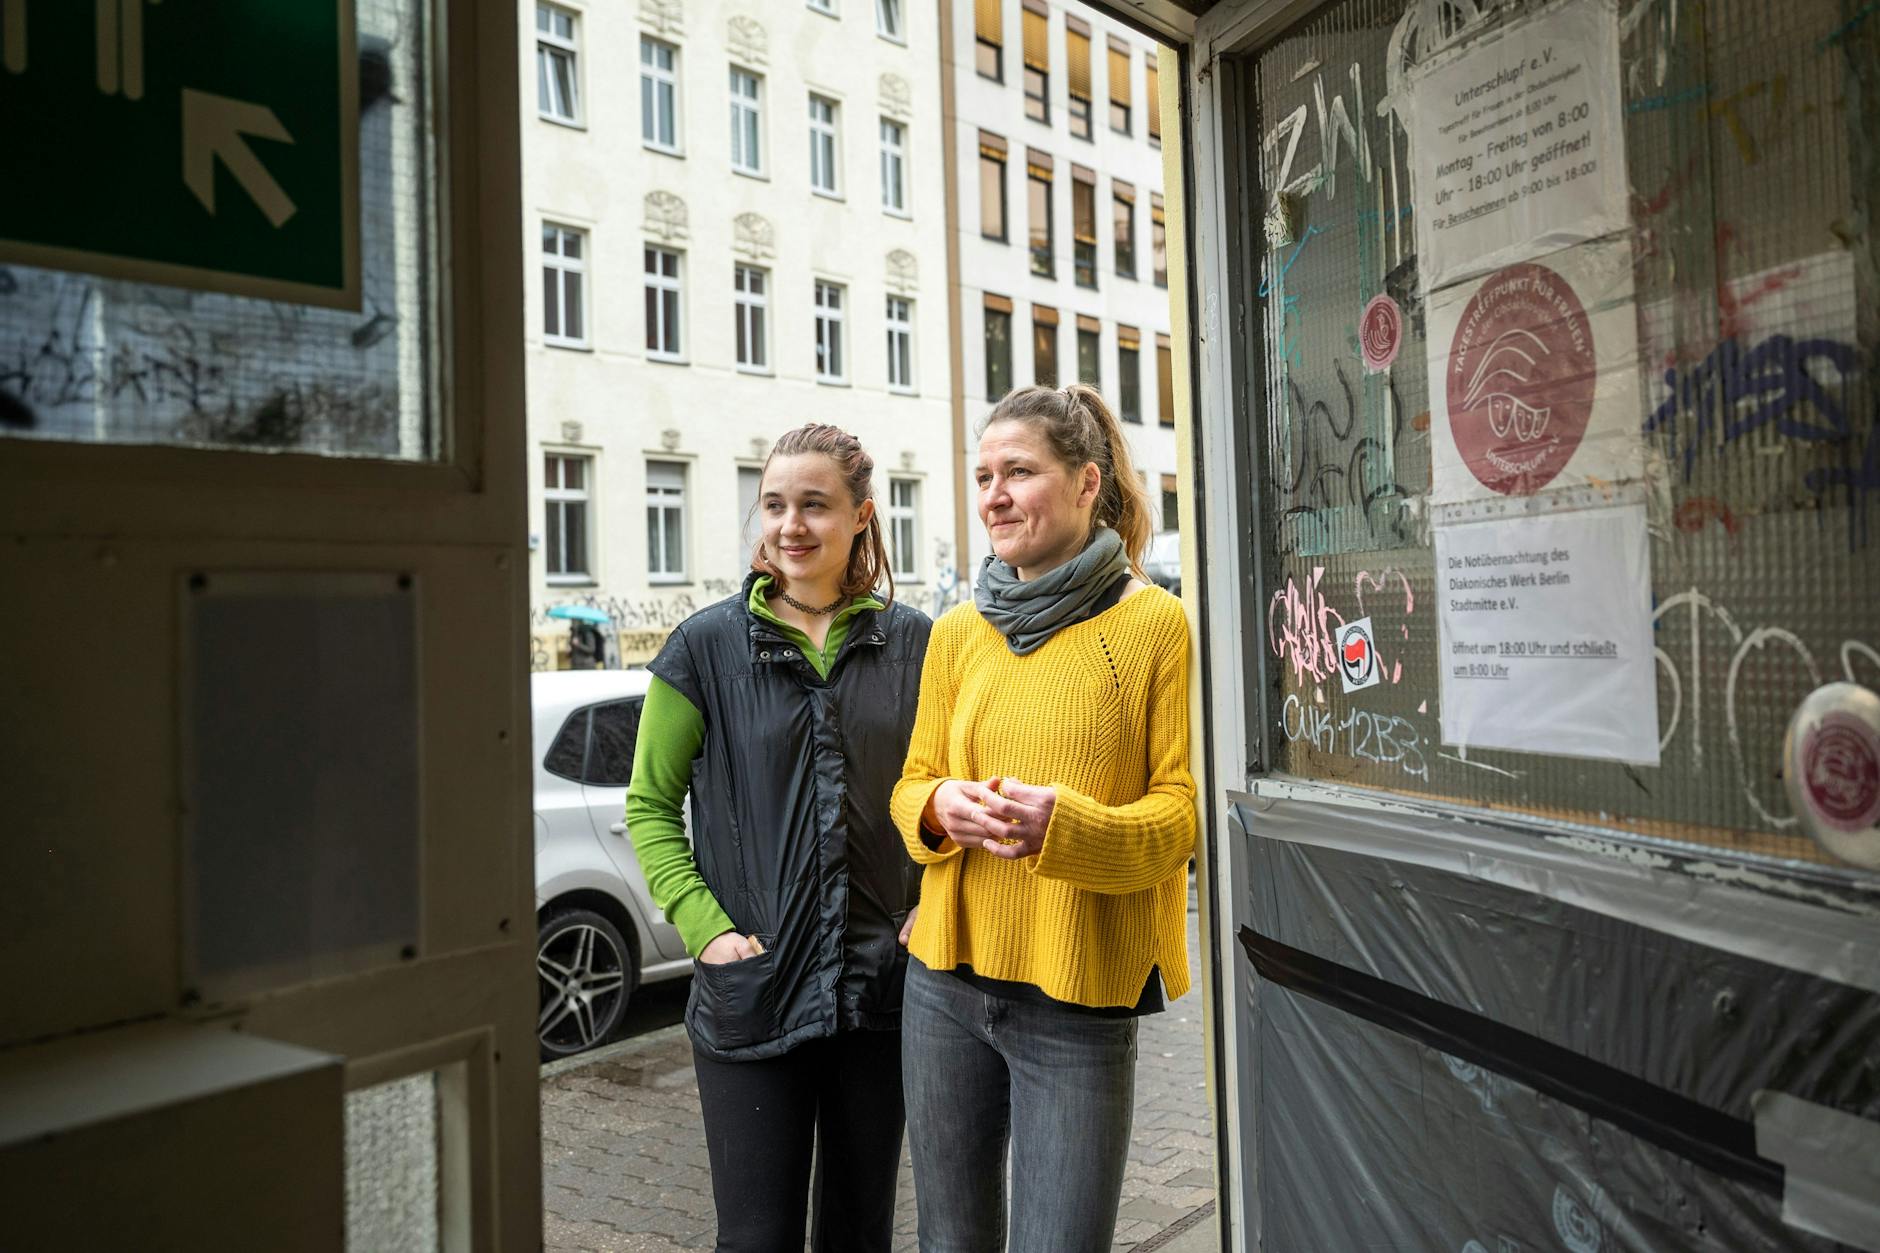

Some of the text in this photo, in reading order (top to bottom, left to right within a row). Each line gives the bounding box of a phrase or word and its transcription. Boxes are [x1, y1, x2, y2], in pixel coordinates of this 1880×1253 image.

[1455, 47, 1557, 107] Unterschlupf e.V.
[1436, 154, 1474, 180] Montag
[1487, 131, 1529, 159] Freitag
[1531, 121, 1554, 139] von
[1557, 101, 1590, 130] 8:00
[1435, 187, 1454, 206] Uhr
[1468, 166, 1503, 193] 18:00
[1505, 159, 1529, 178] Uhr
[1531, 130, 1592, 173] geöffnet!
[1432, 217, 1446, 231] Für
[1447, 194, 1507, 227] Besucherinnen
[1508, 190, 1519, 203] ab
[1546, 174, 1561, 189] bis
[1455, 278, 1530, 374] TAGESTREFFPUNKT
[1448, 548, 1570, 569] Die Notübernachtung des
[1449, 571, 1571, 591] Diakonisches Werk Berlin
[1450, 597, 1519, 612] Stadtmitte e.V.
[1452, 641, 1618, 656] öffnet um 18:00 Uhr und schließt
[1453, 664, 1509, 677] um 8:00 Uhr
